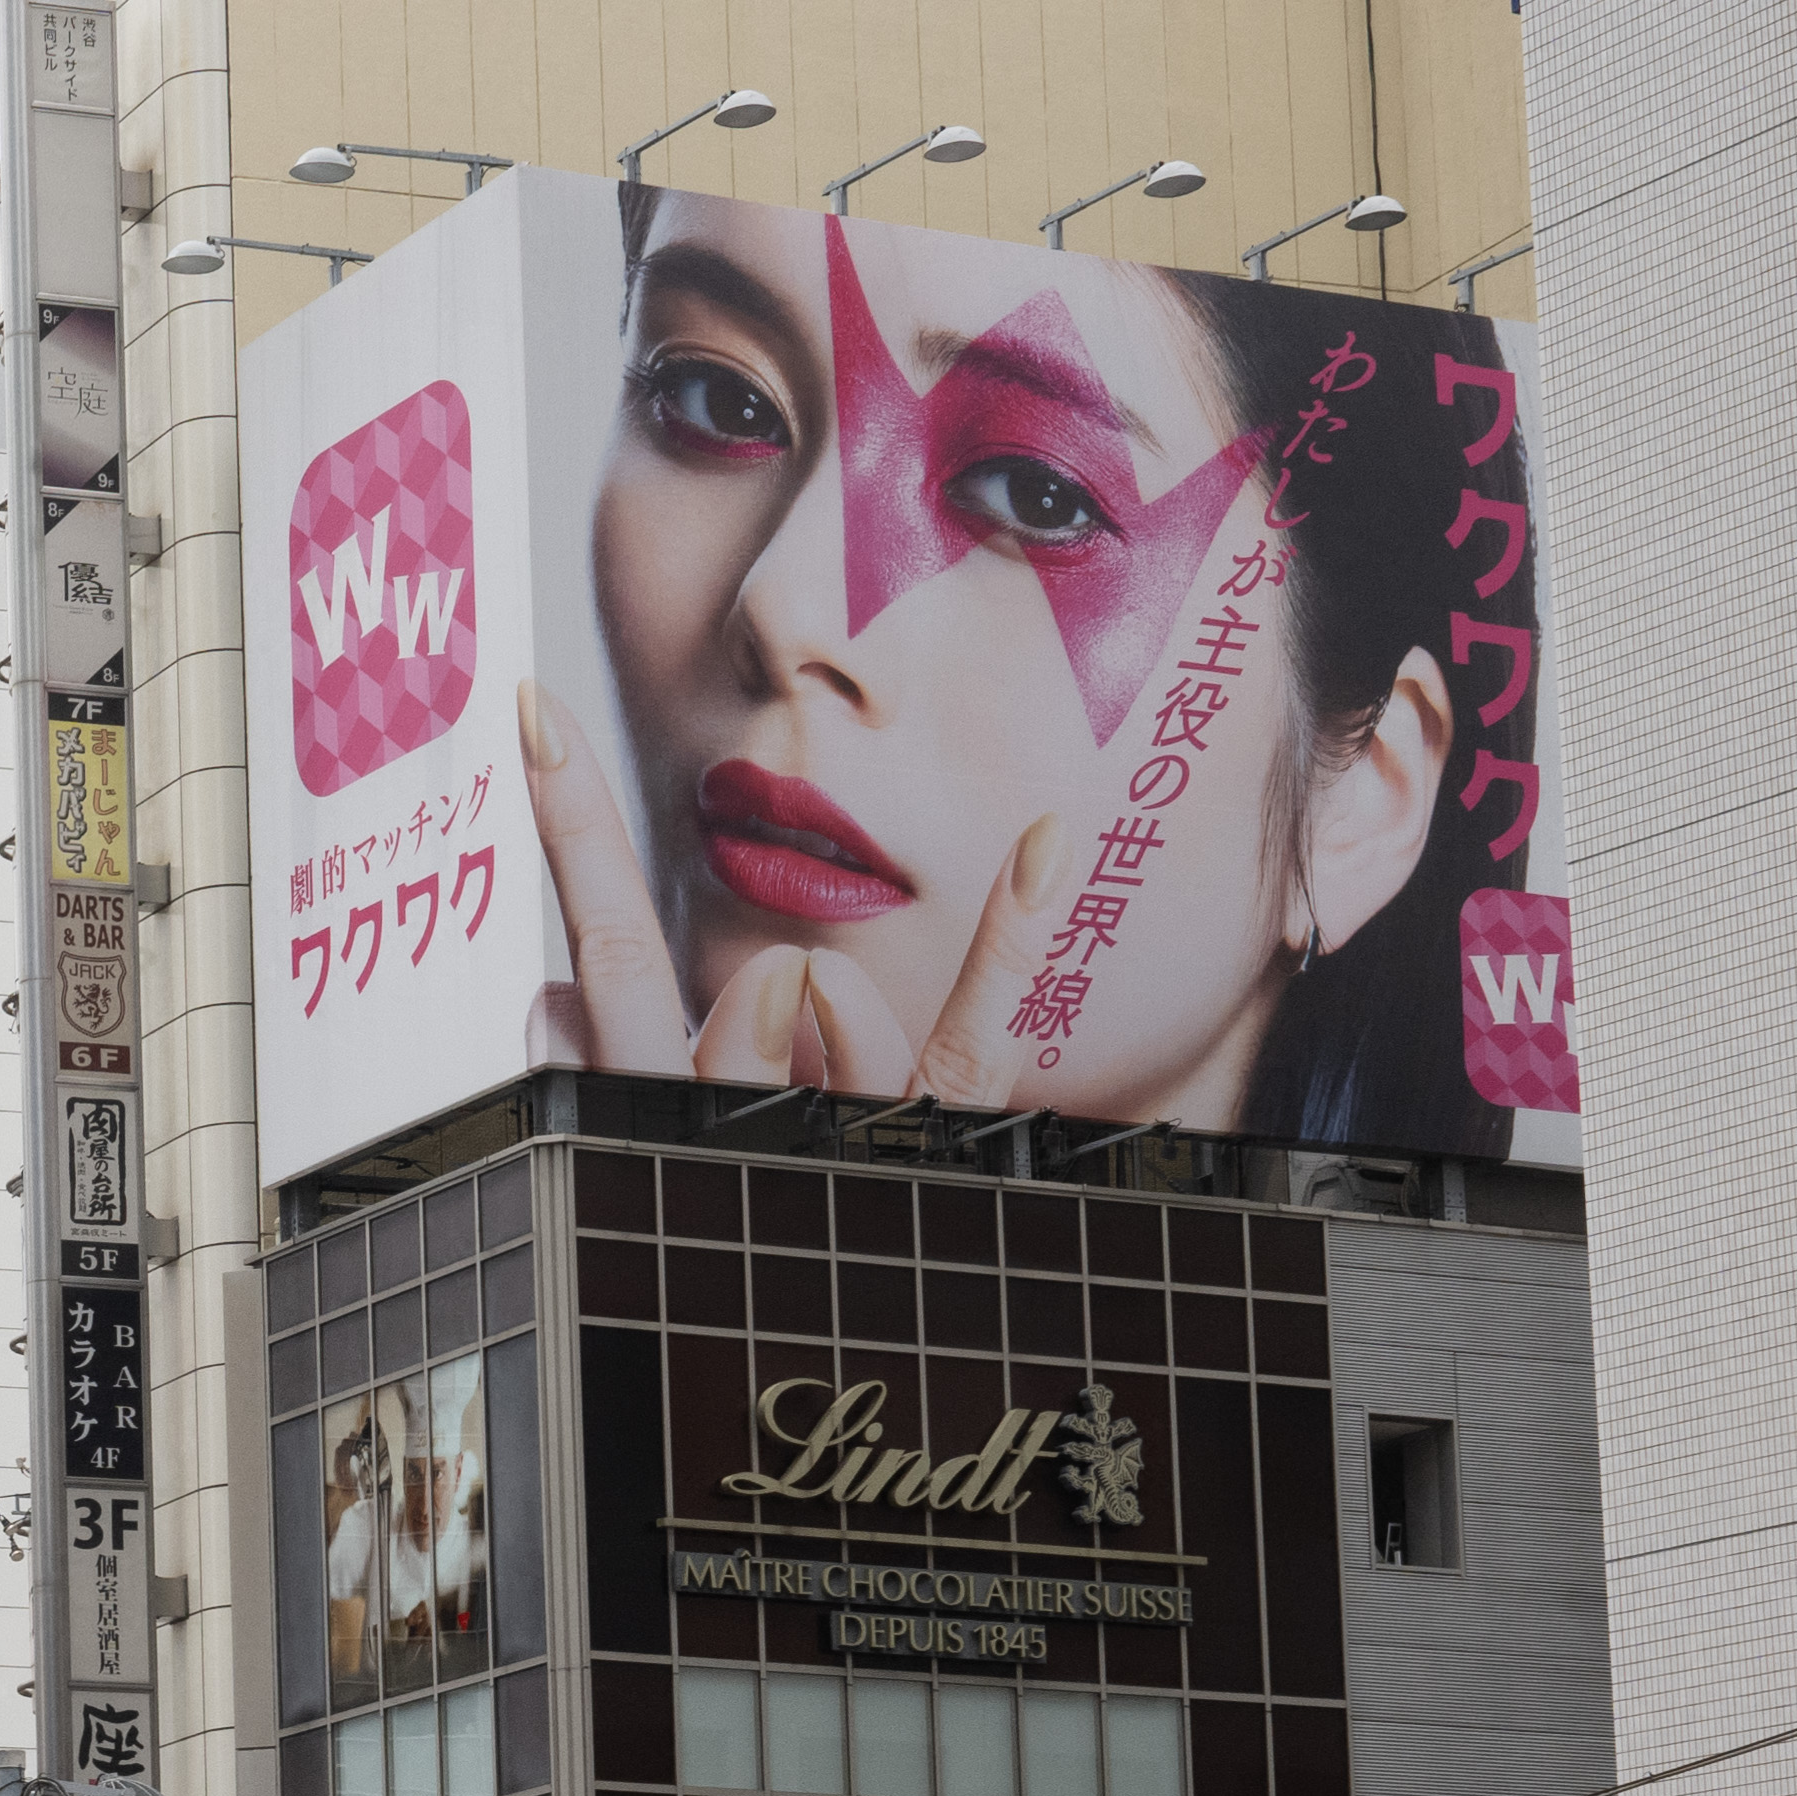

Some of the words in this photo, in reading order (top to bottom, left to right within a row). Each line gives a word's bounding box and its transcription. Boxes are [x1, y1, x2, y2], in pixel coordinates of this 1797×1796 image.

[43, 13, 58, 72] 共同ビル
[63, 15, 78, 101] パークサイド
[82, 18, 97, 48] 渋谷
[43, 309, 60, 326] 9F
[98, 472, 116, 489] 9F
[48, 501, 65, 518] 8F
[1434, 353, 1542, 861] ワクワク
[103, 667, 120, 684] 8F
[1007, 330, 1378, 1071] わたしが主役の世界線。
[67, 698, 104, 721] 7F
[91, 728, 121, 877] まーじゃん
[289, 763, 495, 916] 劇的マッチング
[56, 892, 124, 922] DARTS
[291, 844, 495, 1020] ワクワク
[63, 927, 76, 946] &
[83, 921, 125, 950] BAR
[68, 961, 116, 980] JACK
[78, 1246, 120, 1271] 5F
[68, 1302, 99, 1442] カラオケ
[113, 1324, 139, 1430] BAR
[90, 1446, 121, 1470] 4F
[720, 1377, 1061, 1515] Lindt
[73, 1498, 139, 1551] 3F
[681, 1551, 814, 1599] MAÎTRE
[821, 1563, 1092, 1617] CHOCOLATIER
[1084, 1582, 1194, 1623] SUISSE
[95, 1553, 122, 1676] 個室居酒屋
[838, 1613, 964, 1653] DEPUIS
[974, 1624, 1048, 1660] 1845
